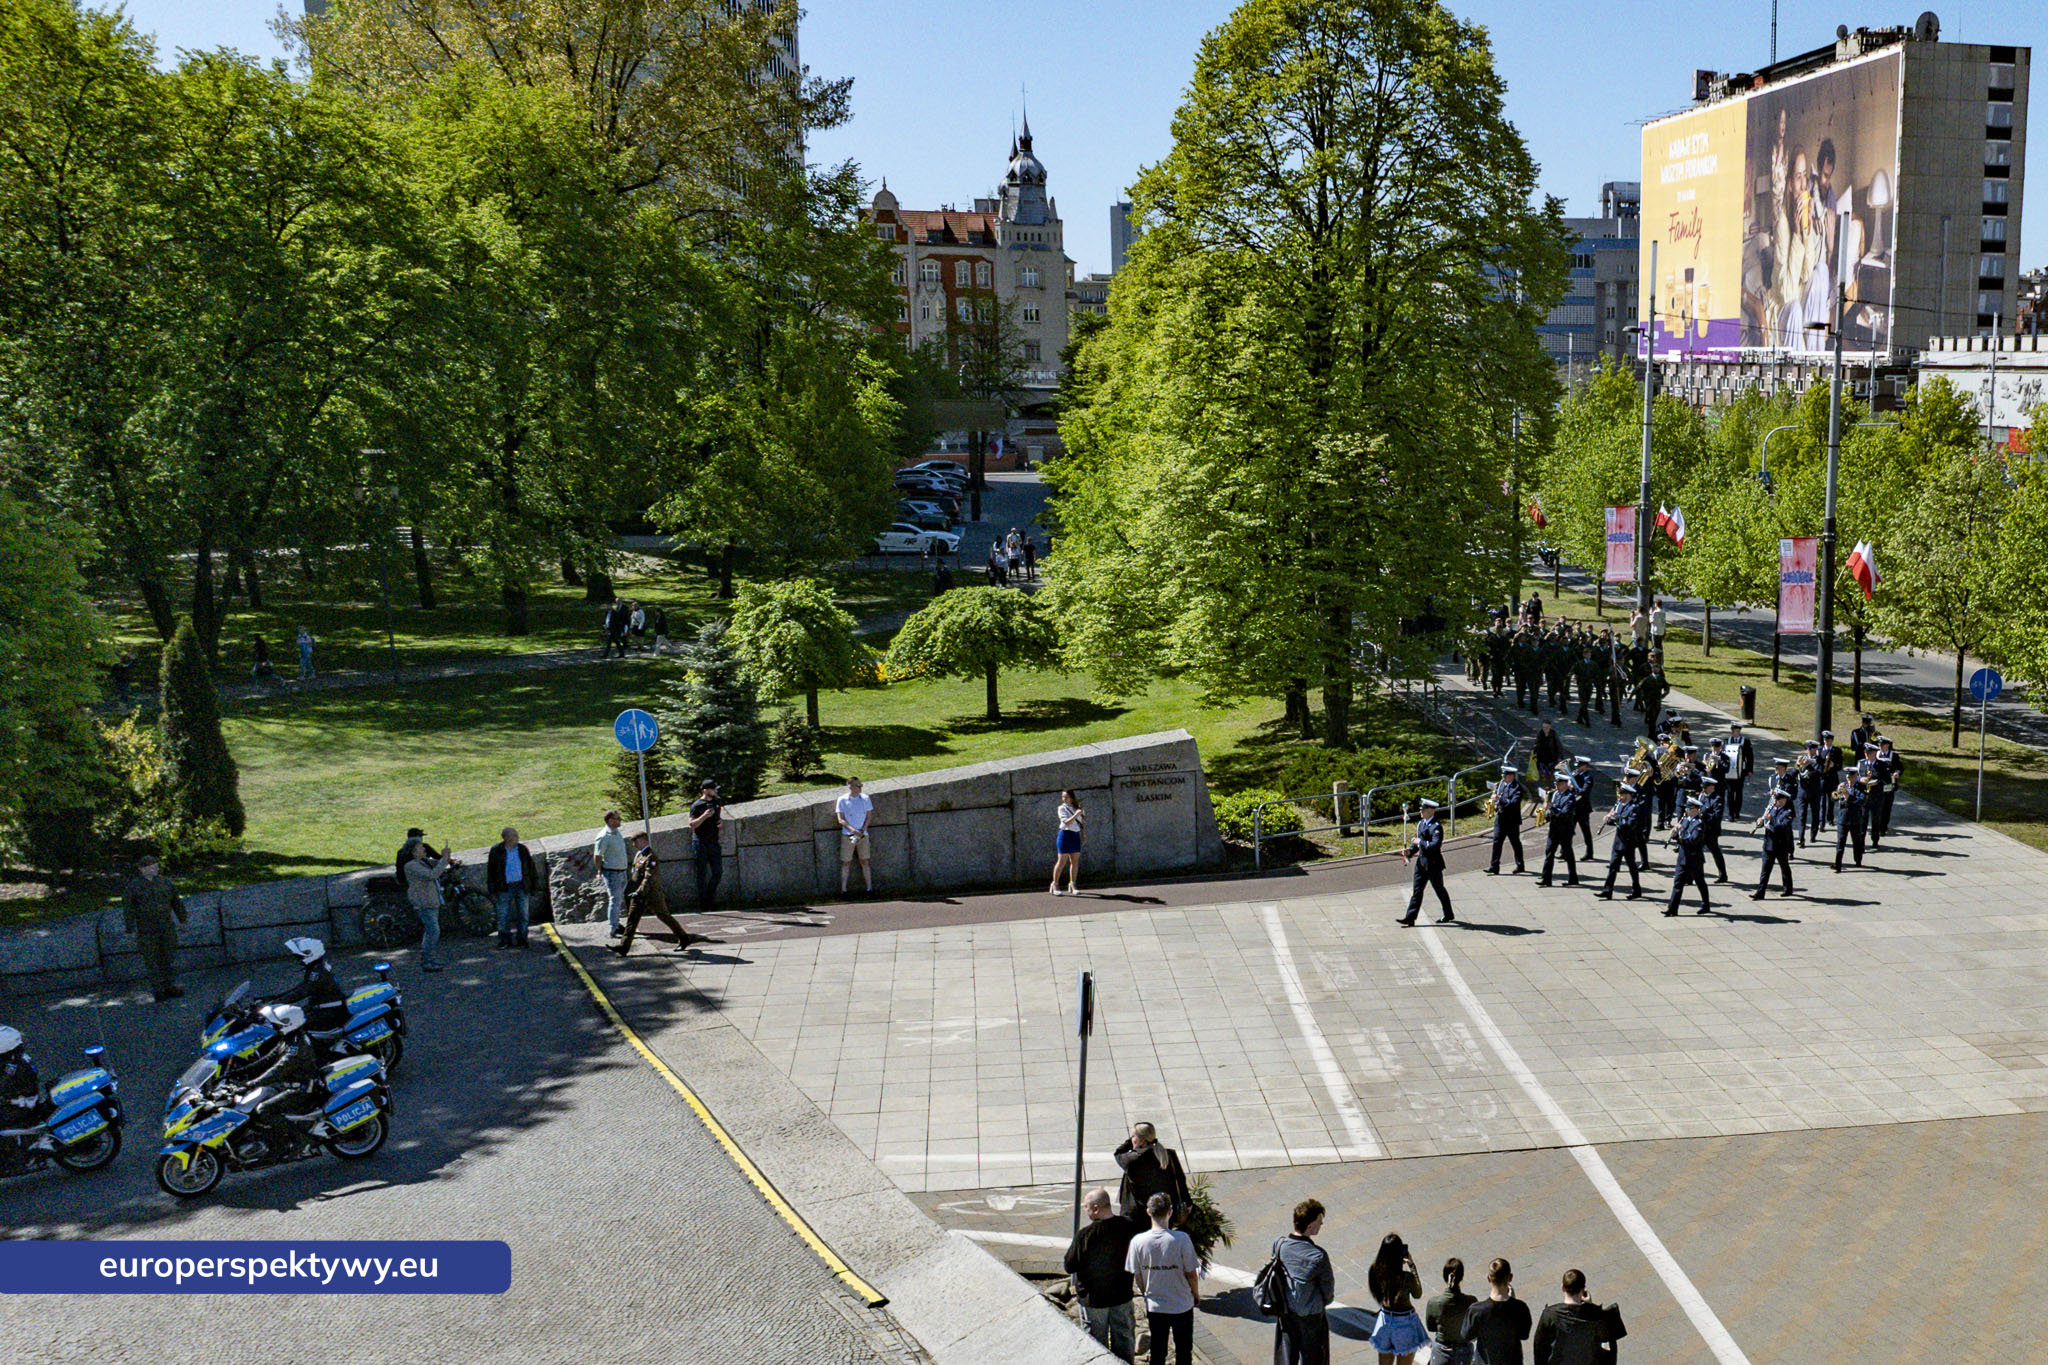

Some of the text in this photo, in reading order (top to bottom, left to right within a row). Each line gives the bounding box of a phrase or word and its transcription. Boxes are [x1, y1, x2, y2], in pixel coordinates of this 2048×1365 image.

[1668, 206, 1703, 260] Family
[1129, 763, 1177, 773] WARSZAWA
[1120, 776, 1186, 789] POWSTAŃCOM
[354, 1023, 387, 1042] LICJA
[336, 1103, 372, 1124] POLICJA
[60, 1114, 101, 1137] POLICJA
